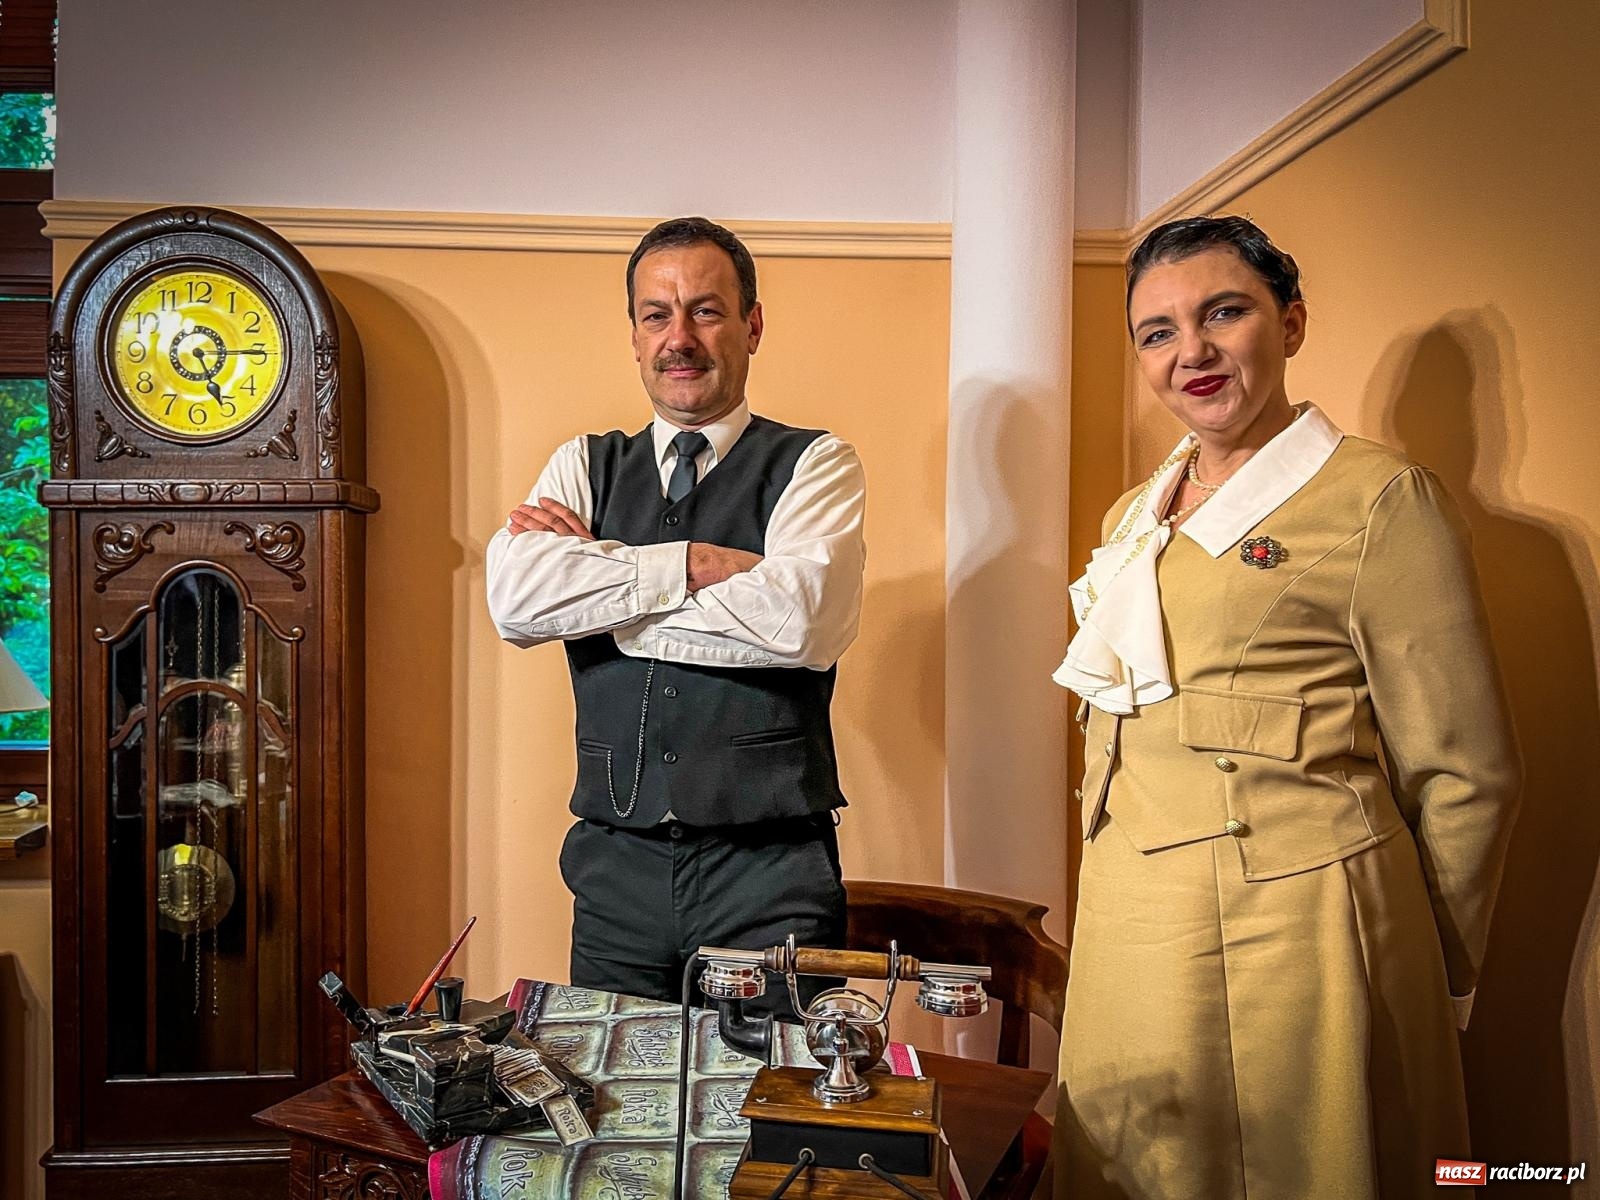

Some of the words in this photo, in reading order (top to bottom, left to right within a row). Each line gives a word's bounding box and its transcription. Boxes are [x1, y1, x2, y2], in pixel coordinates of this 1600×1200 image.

[157, 290, 177, 312] 11
[184, 281, 213, 304] 12
[227, 291, 236, 314] 1
[133, 312, 160, 334] 10
[242, 311, 261, 333] 2
[128, 341, 146, 363] 9
[249, 343, 268, 365] 3
[136, 371, 154, 393] 8
[239, 375, 257, 396] 4
[161, 394, 178, 416] 7
[188, 402, 208, 425] 6
[219, 396, 236, 417] 5
[622, 1089, 659, 1125] Roka
[556, 1106, 577, 1134] Roka
